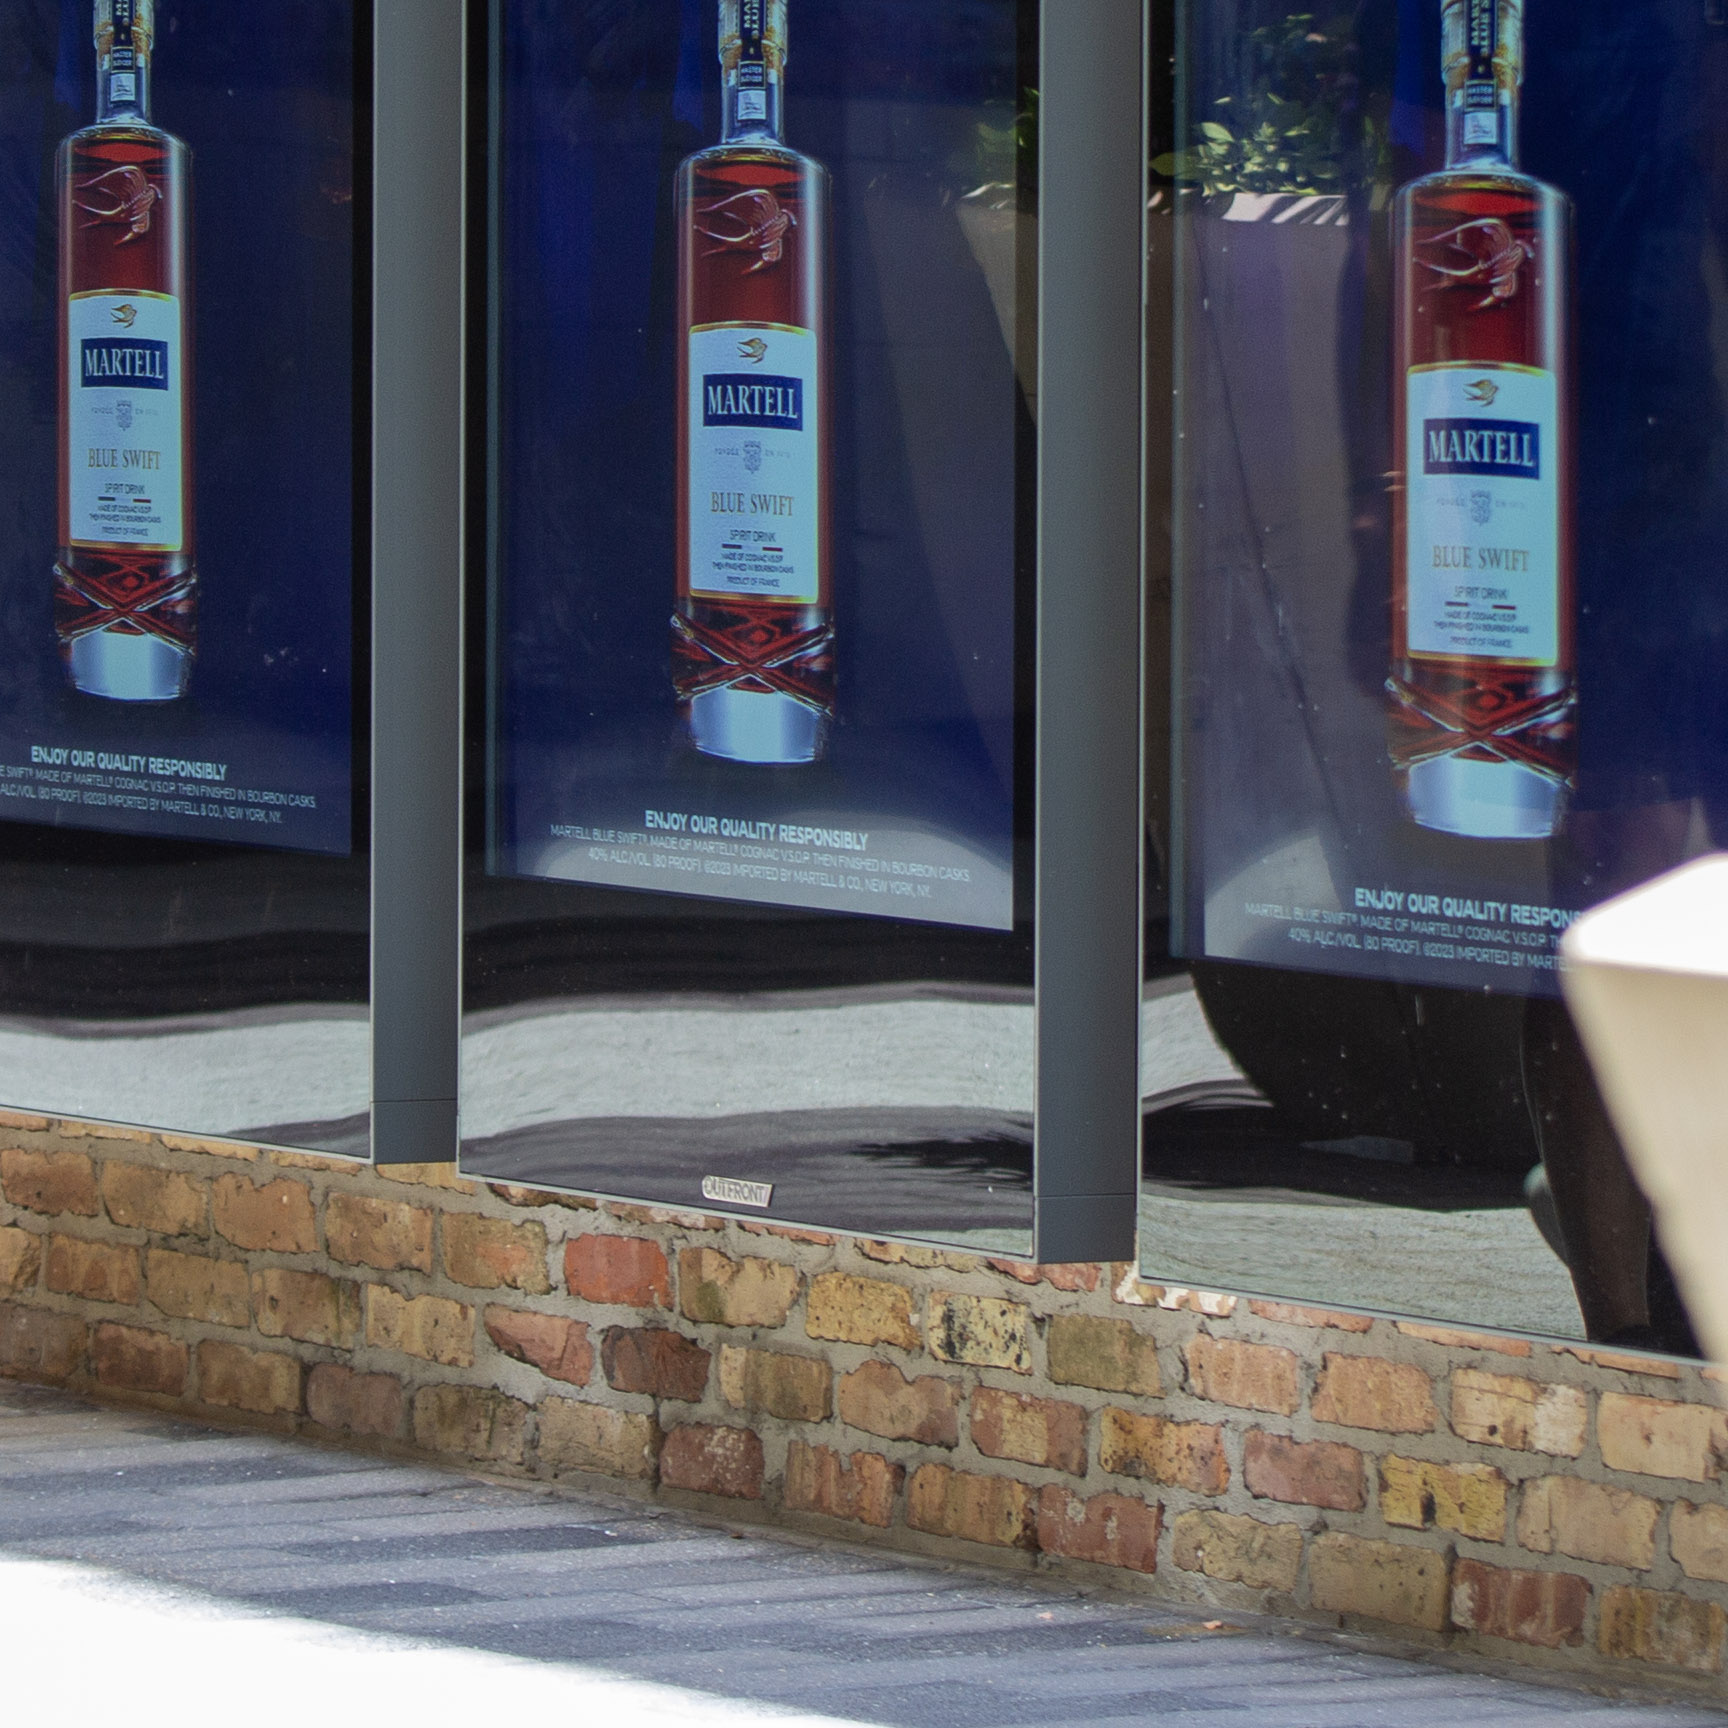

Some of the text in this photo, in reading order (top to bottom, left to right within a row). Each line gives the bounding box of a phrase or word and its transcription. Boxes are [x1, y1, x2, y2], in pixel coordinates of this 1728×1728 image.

[85, 348, 164, 379] MARTELL
[707, 385, 798, 419] MARTELL
[88, 448, 160, 470] BLUE SWIFT
[1429, 430, 1534, 467] MARTELL
[710, 491, 795, 516] BLUE SWIFT
[1432, 545, 1529, 571] BLUE SWIFT
[31, 746, 227, 781] ENJOY OUR QUALITY RESPONSIBLY
[645, 810, 868, 851] ENJOY OUR QUALITY RESPONSIBLY
[550, 824, 591, 840] MARTELL
[592, 828, 615, 843] BLUE
[650, 835, 678, 850] MADE
[679, 837, 692, 851] OF
[740, 844, 779, 861] COGNAC
[813, 852, 838, 868] THEN
[839, 854, 879, 872] FINISHED
[891, 861, 938, 878] BOURBON
[732, 862, 778, 881] IMPORTED
[780, 868, 793, 883] BY
[794, 870, 837, 888] MARTELL
[864, 878, 887, 893] NEW
[1354, 887, 1404, 911] ENJOY
[1407, 893, 1440, 915] OUR
[1443, 897, 1507, 922] QUALITY
[1244, 903, 1291, 920] MARTELL
[1293, 907, 1320, 923] BLUE
[1360, 915, 1392, 931] MADE
[1394, 918, 1409, 932] OF
[1465, 926, 1511, 944] COGNAC
[1288, 927, 1311, 944] 40%
[1456, 945, 1510, 965] IMPORTED
[1511, 951, 1526, 967] BY
